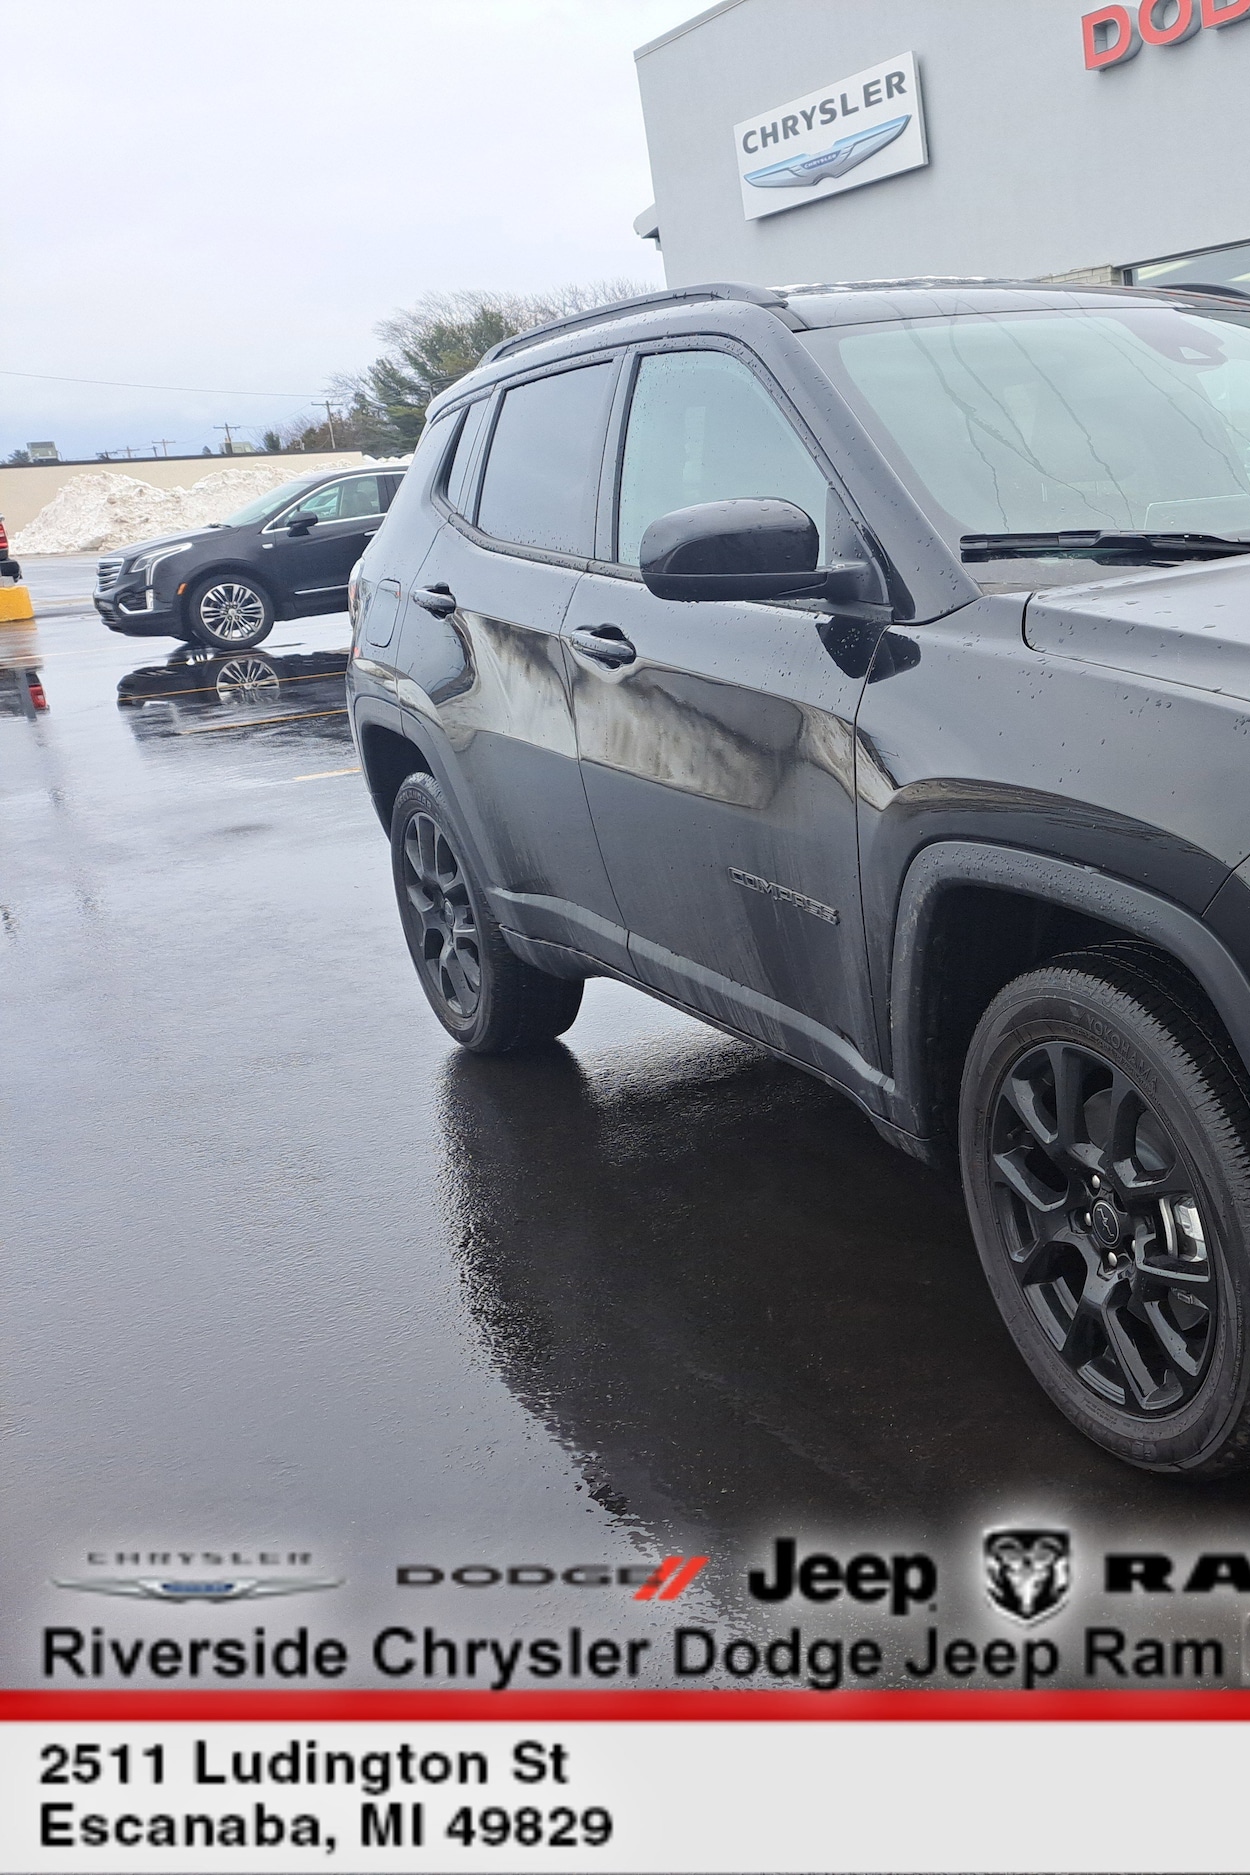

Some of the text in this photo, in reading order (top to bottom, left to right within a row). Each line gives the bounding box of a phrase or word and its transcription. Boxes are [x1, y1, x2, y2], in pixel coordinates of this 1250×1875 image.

[742, 70, 907, 156] CHRYSLER
[803, 153, 838, 169] CHRYSLER
[727, 865, 841, 926] COMPASS
